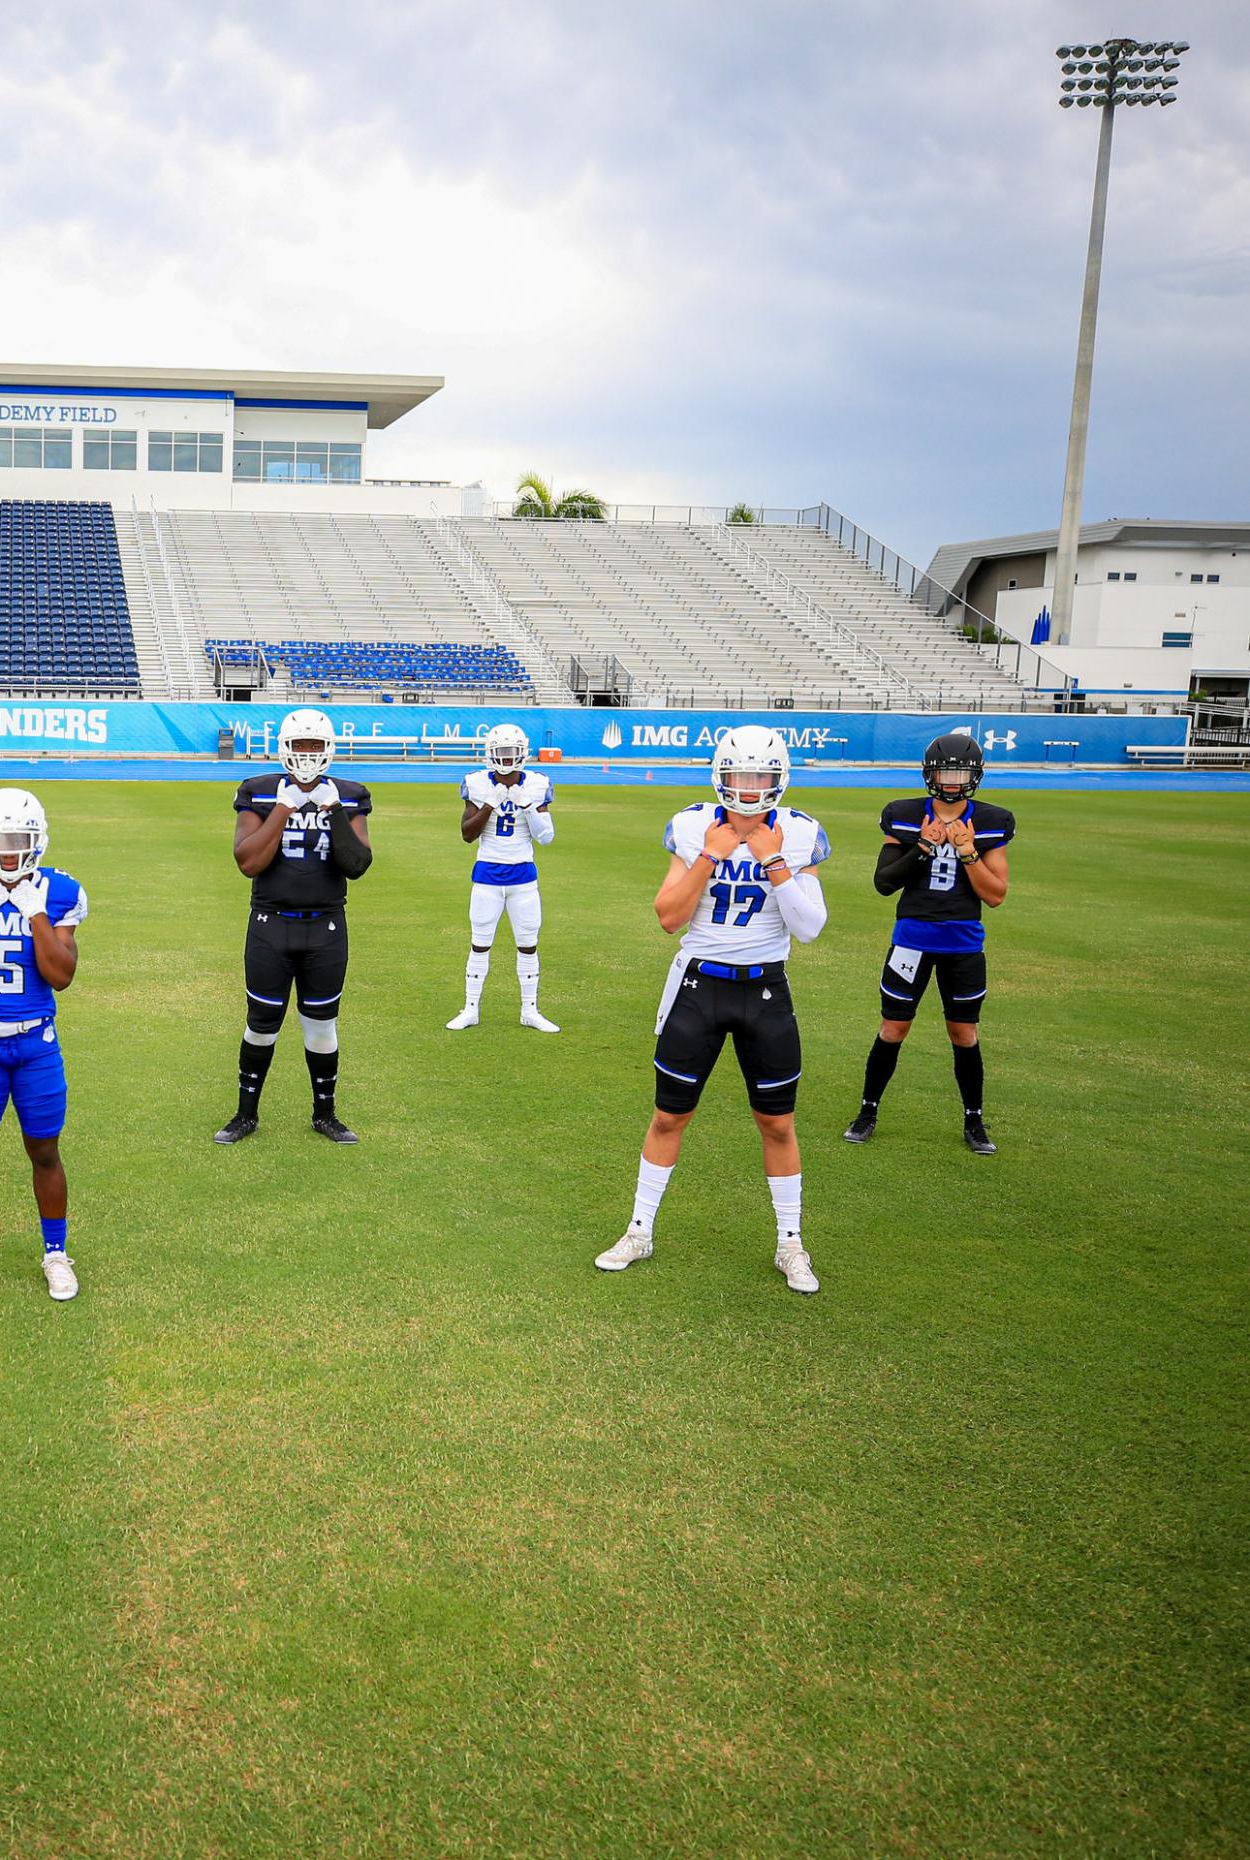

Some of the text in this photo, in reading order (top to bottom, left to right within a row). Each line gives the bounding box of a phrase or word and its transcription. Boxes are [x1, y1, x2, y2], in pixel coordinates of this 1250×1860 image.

[59, 407, 117, 423] FIELD
[342, 722, 384, 738] RE
[632, 725, 688, 747] IMG
[710, 882, 767, 927] 17
